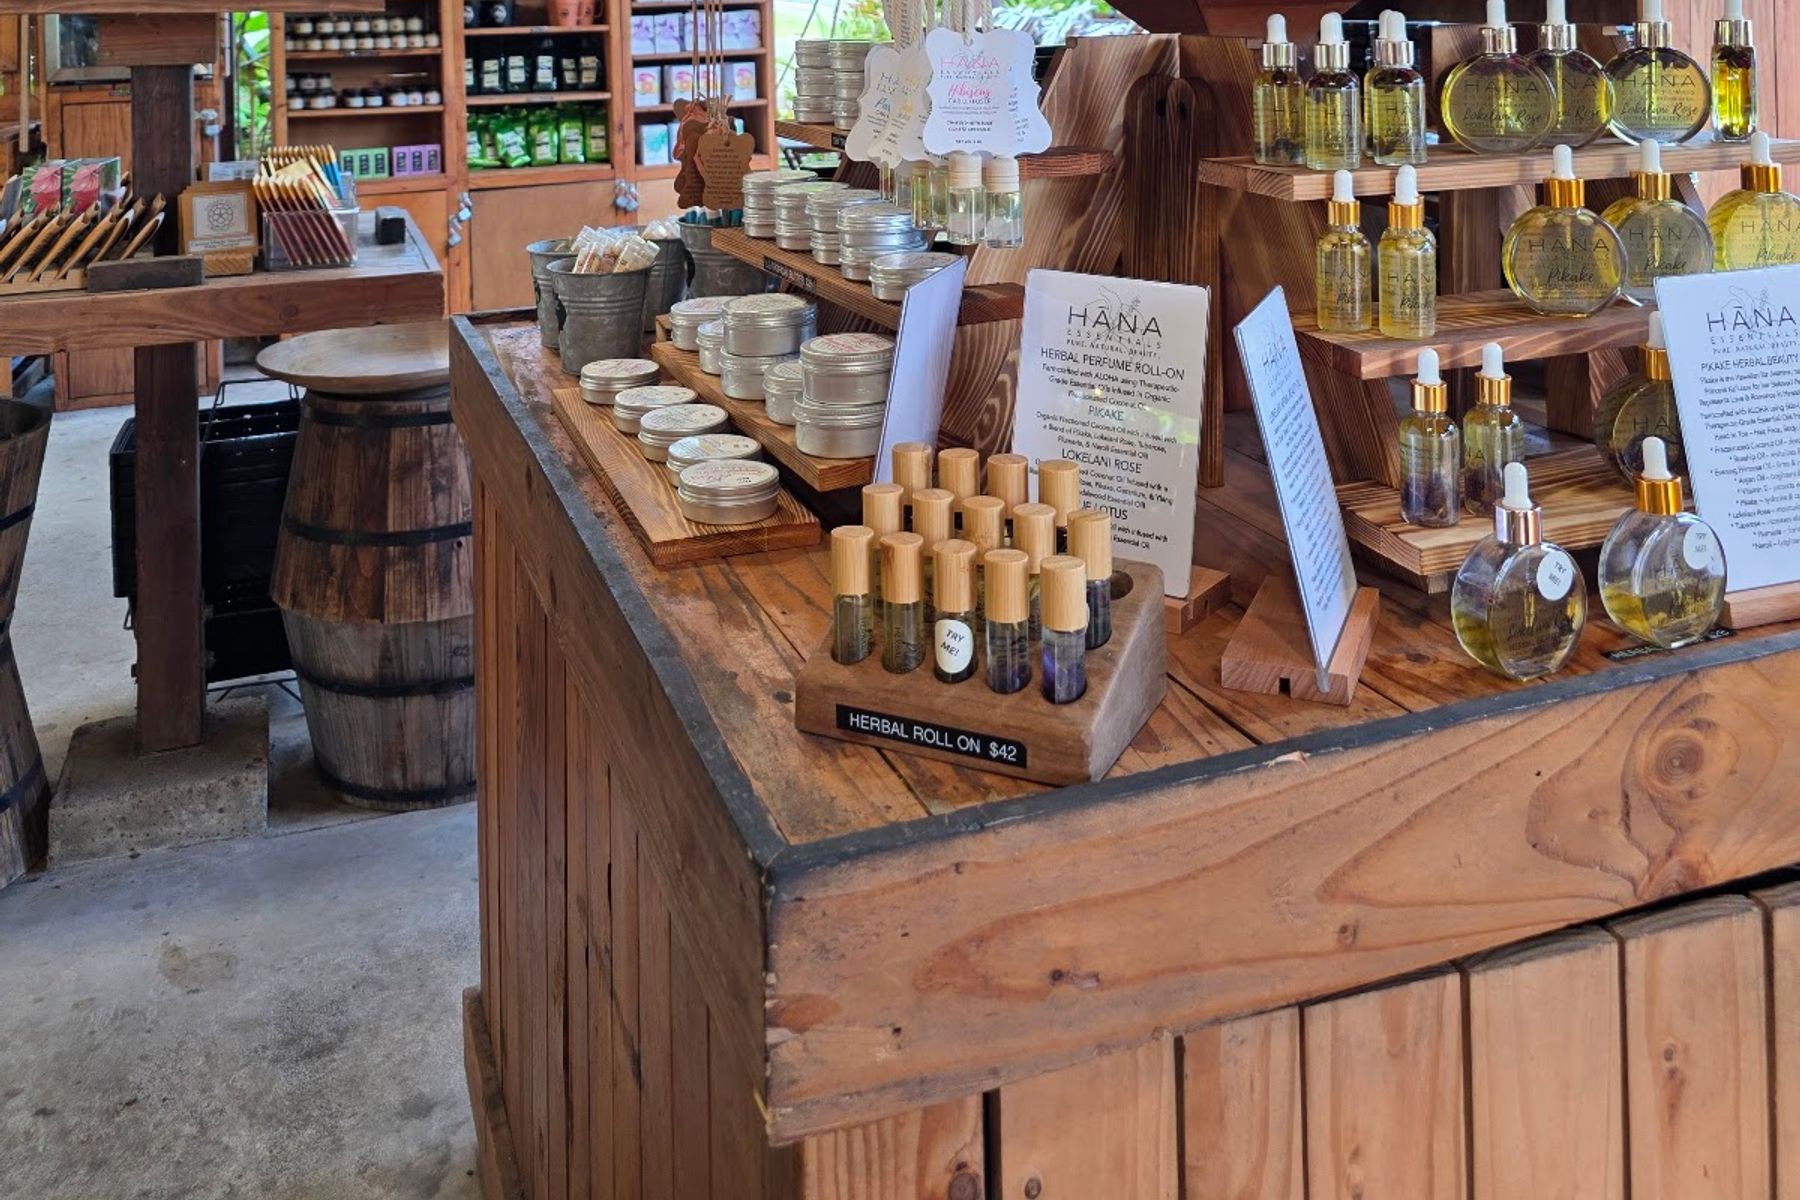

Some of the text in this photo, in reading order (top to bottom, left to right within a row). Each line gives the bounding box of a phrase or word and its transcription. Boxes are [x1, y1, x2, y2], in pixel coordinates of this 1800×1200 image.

[1068, 305, 1162, 338] HĀNA
[1706, 306, 1796, 332] HĀNA
[1066, 330, 1162, 349] ESSENTIALS
[1041, 347, 1185, 380] HERBAL PERFUME ROLL-ON
[1701, 353, 1798, 371] PIKAKE HERBAL BEAUTY
[1094, 371, 1119, 383] ALOHA
[1088, 405, 1124, 421] PIKAKE
[1090, 420, 1116, 433] Coconut
[1062, 449, 1142, 473] LOKELANI ROSE
[947, 630, 965, 643] TRY
[940, 641, 960, 656] ME!
[850, 713, 1017, 761] HERBAL ROLL ON $42
